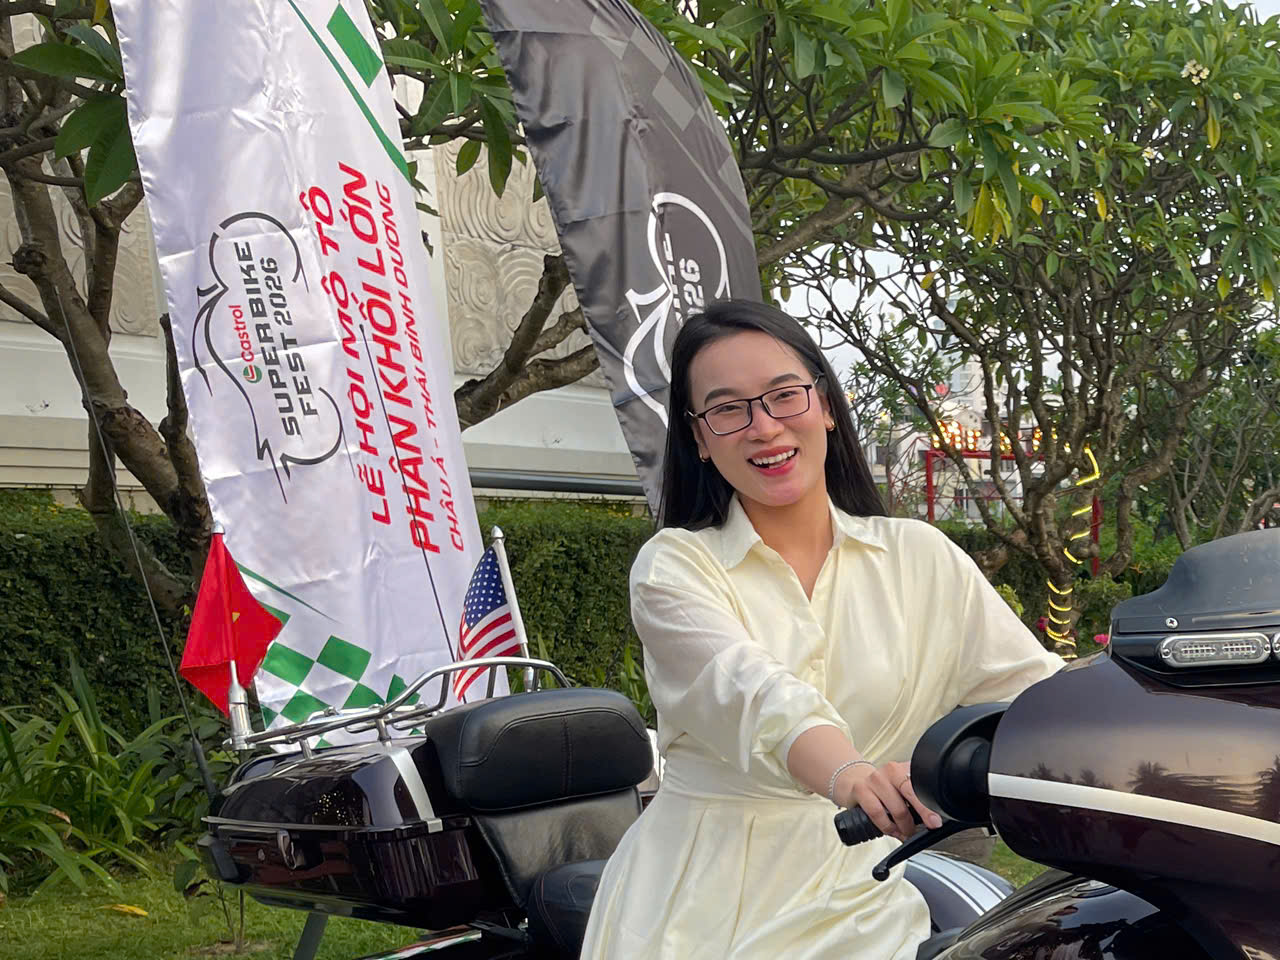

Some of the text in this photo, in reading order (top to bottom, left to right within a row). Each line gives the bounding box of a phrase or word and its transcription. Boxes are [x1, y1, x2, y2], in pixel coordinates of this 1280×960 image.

[376, 180, 408, 289] DƯƠNG
[228, 304, 254, 362] Castrol
[234, 241, 301, 436] SUPERBIKE
[260, 257, 319, 416] FEST 2026
[299, 186, 391, 525] LỄ HỘI MÔ TÔ
[338, 161, 440, 554] PHÂN KHỐI LỚN
[399, 290, 423, 363] BÌNH
[413, 366, 437, 430] THÁI
[430, 456, 447, 475] Á
[439, 477, 464, 552] CHÂU
